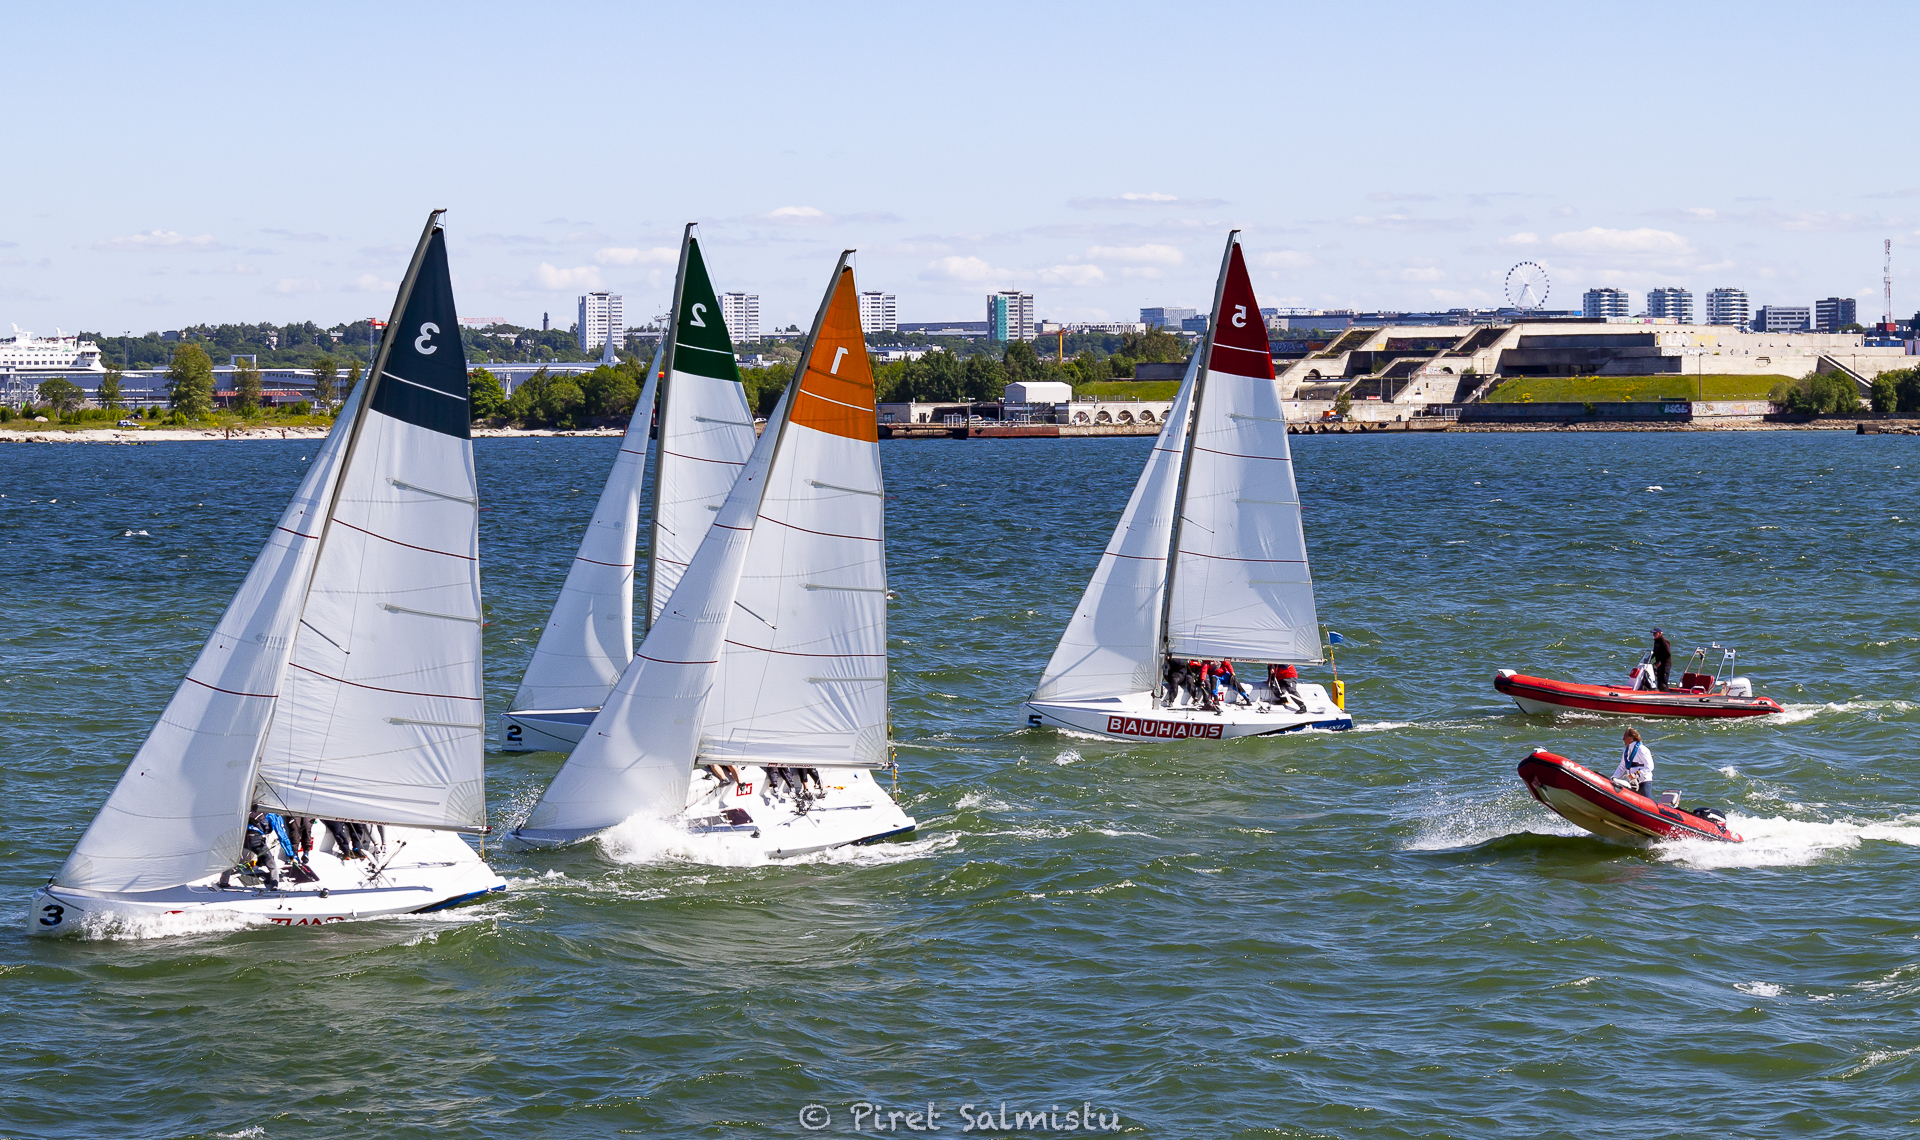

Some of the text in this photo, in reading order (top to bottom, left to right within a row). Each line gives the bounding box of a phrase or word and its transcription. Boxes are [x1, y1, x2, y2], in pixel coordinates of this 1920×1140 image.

[1028, 714, 1043, 728] 5
[1108, 716, 1222, 739] BAUHAUS
[507, 724, 523, 742] 2
[39, 904, 65, 926] 3
